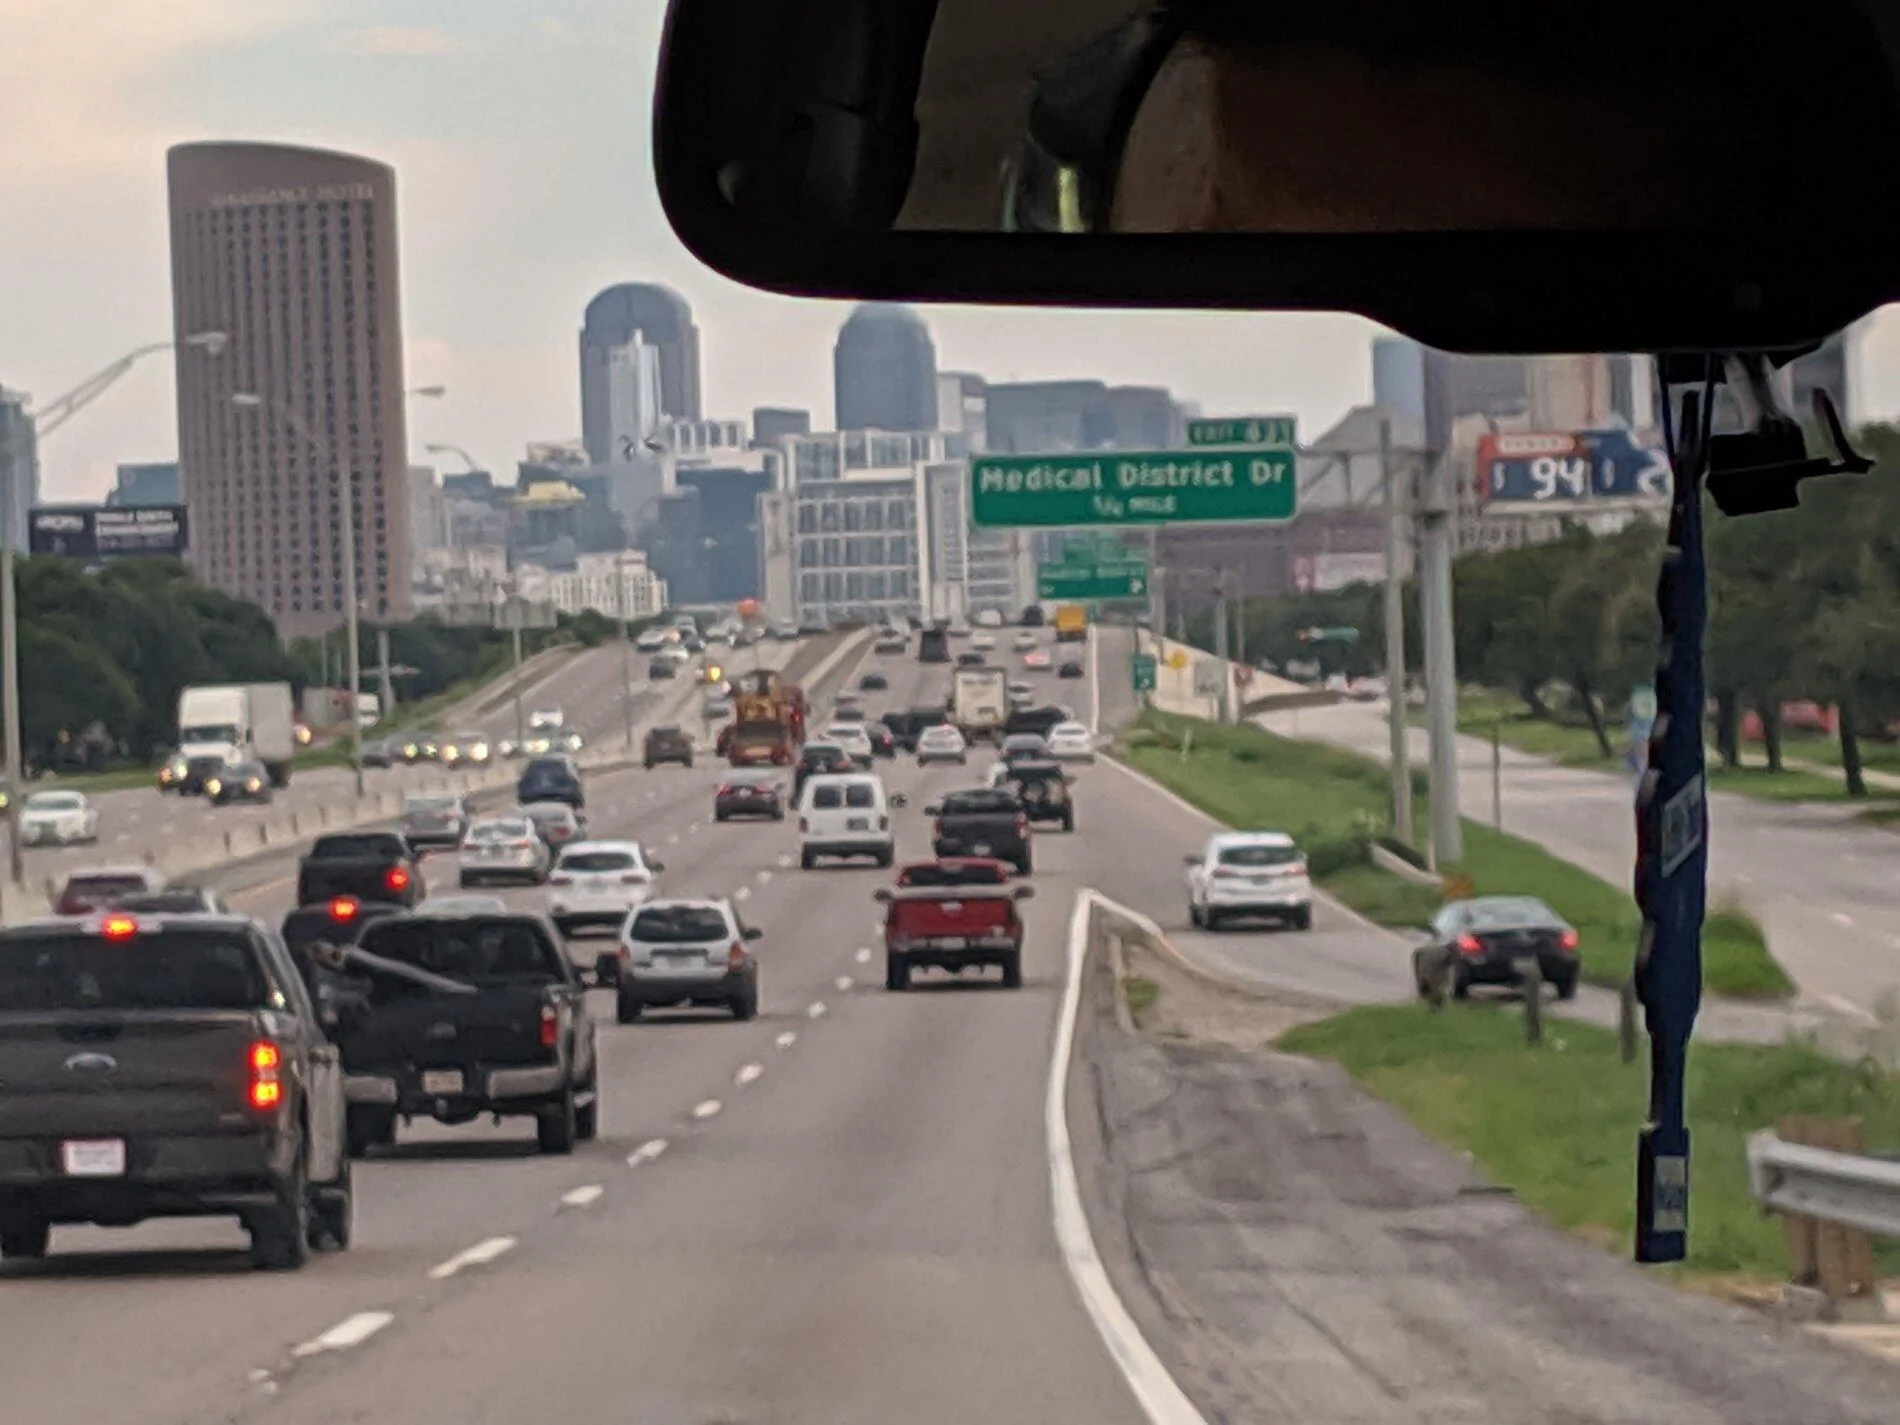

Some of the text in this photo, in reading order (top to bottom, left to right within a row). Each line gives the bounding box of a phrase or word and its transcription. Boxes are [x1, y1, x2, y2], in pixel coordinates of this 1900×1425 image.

[980, 459, 1286, 493] Medical District Dr
[1530, 456, 1586, 499] 94
